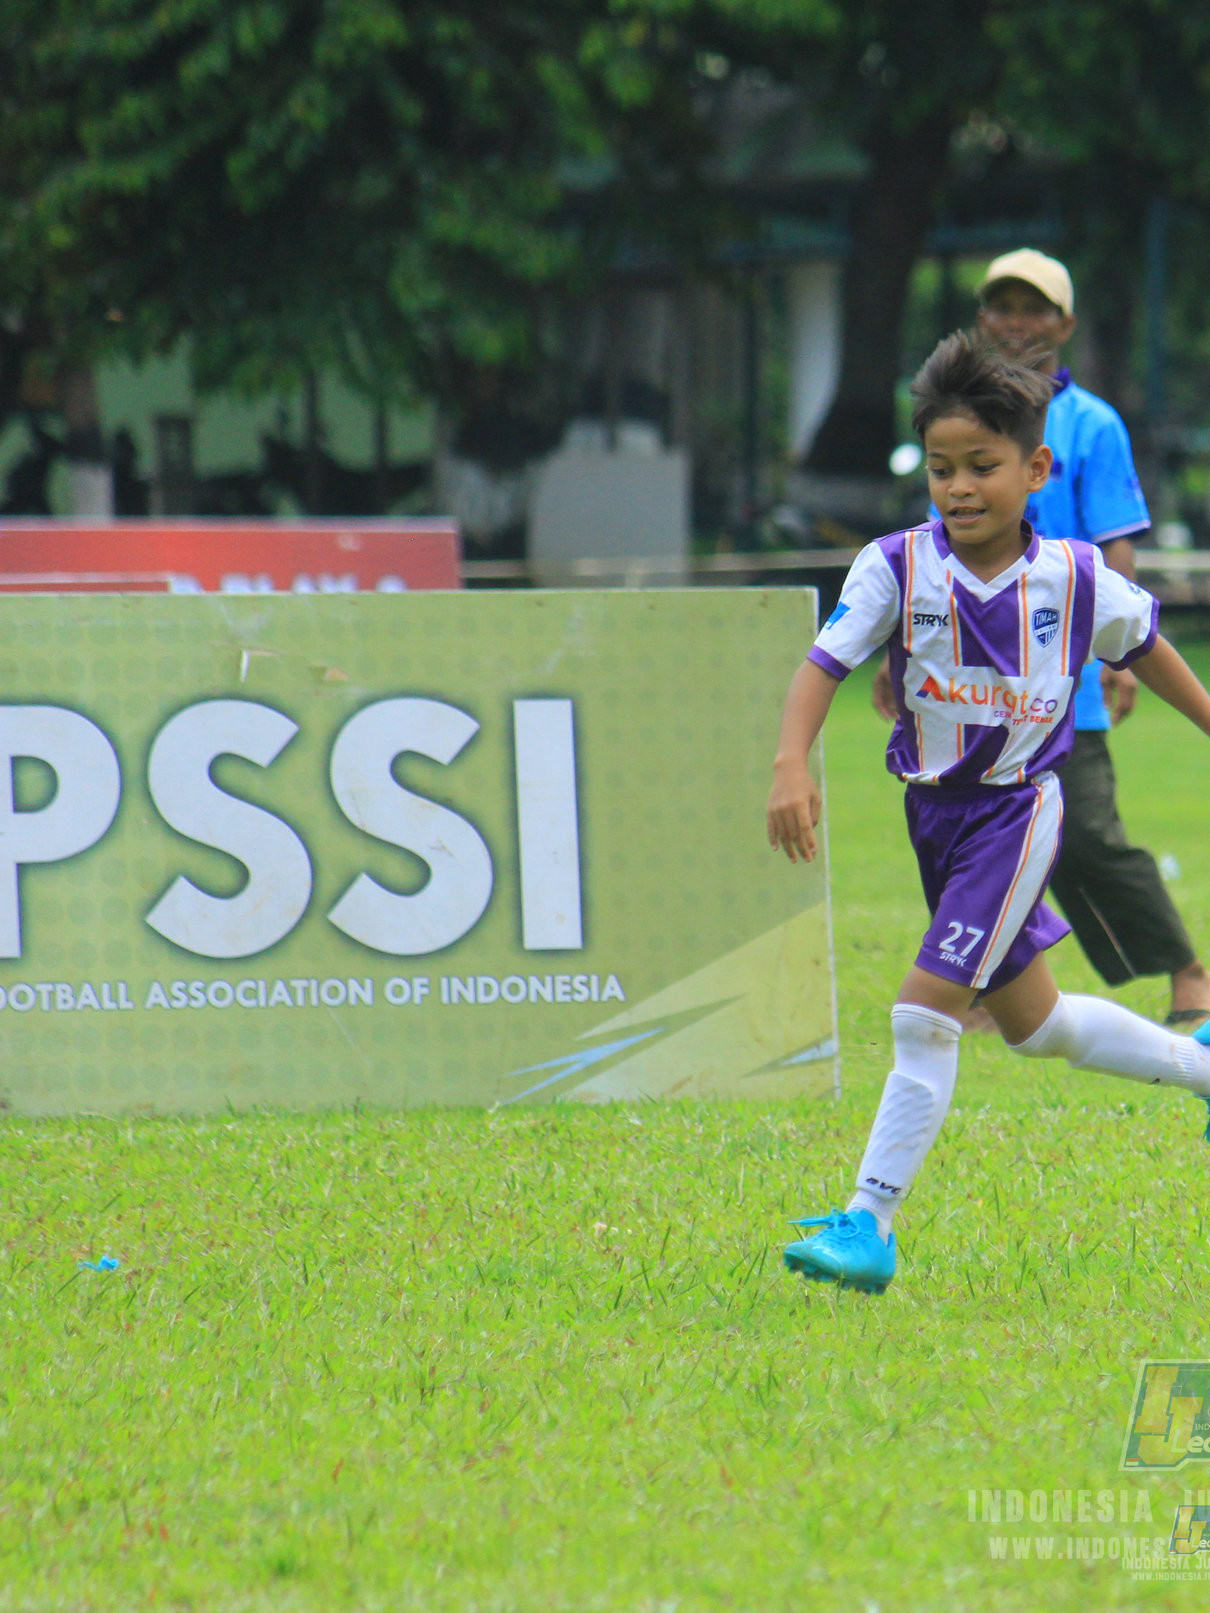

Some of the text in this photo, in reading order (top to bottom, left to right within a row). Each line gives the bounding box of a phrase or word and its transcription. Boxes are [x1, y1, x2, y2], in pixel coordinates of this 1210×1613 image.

[913, 613, 949, 627] STRYK
[0, 697, 584, 959] PSSI
[939, 921, 985, 957] 27
[939, 951, 968, 967] STRYK
[0, 974, 625, 1012] OTBALL ASSOCIATION OF INDONESIA
